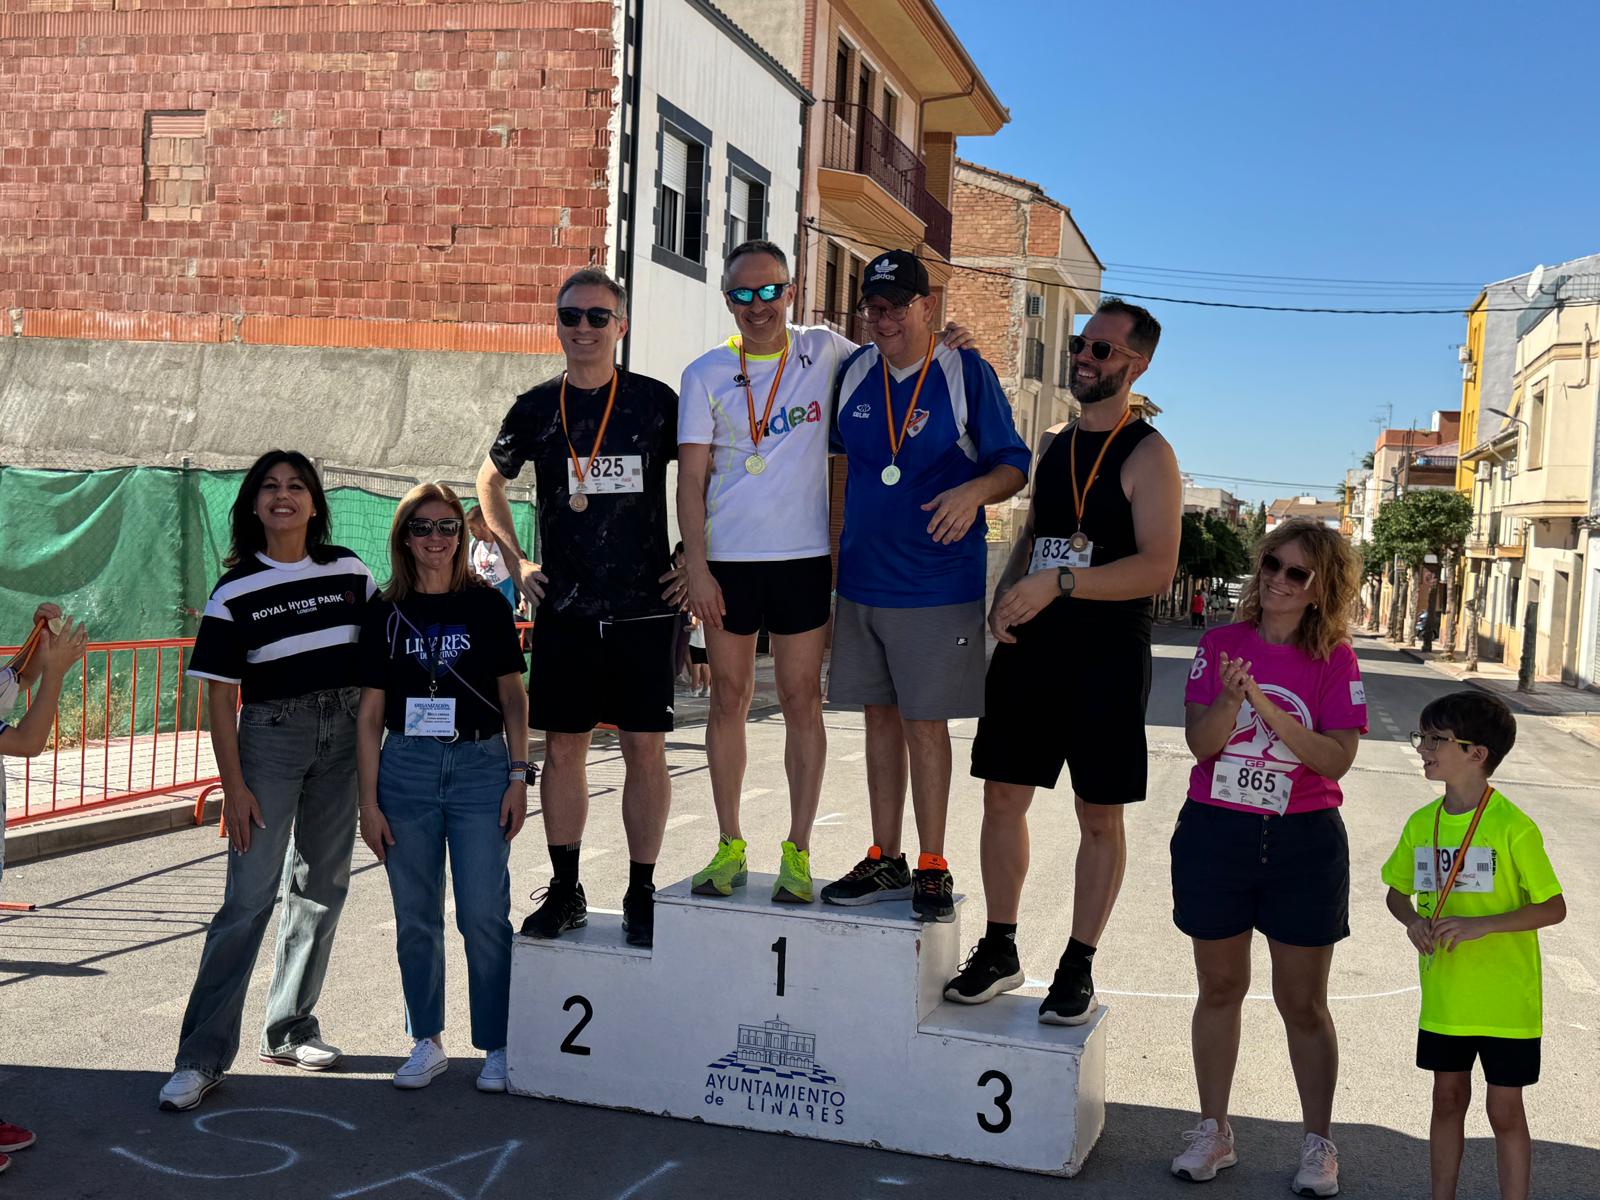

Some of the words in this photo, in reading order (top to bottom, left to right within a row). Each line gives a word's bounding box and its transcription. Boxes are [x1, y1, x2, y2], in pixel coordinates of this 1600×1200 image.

[590, 457, 625, 478] 825
[1042, 538, 1071, 560] 832
[251, 604, 287, 621] ROYAL
[287, 597, 317, 611] HYDE
[317, 593, 344, 605] PARK
[296, 606, 318, 615] LONDON
[1244, 759, 1266, 768] GB
[1237, 767, 1276, 793] 865
[771, 936, 787, 997] 1
[560, 994, 593, 1056] 2
[705, 1072, 846, 1107] AYUNTAMIENTO
[976, 1069, 1013, 1134] 3
[704, 1090, 725, 1106] de
[747, 1095, 845, 1125] LINARES
